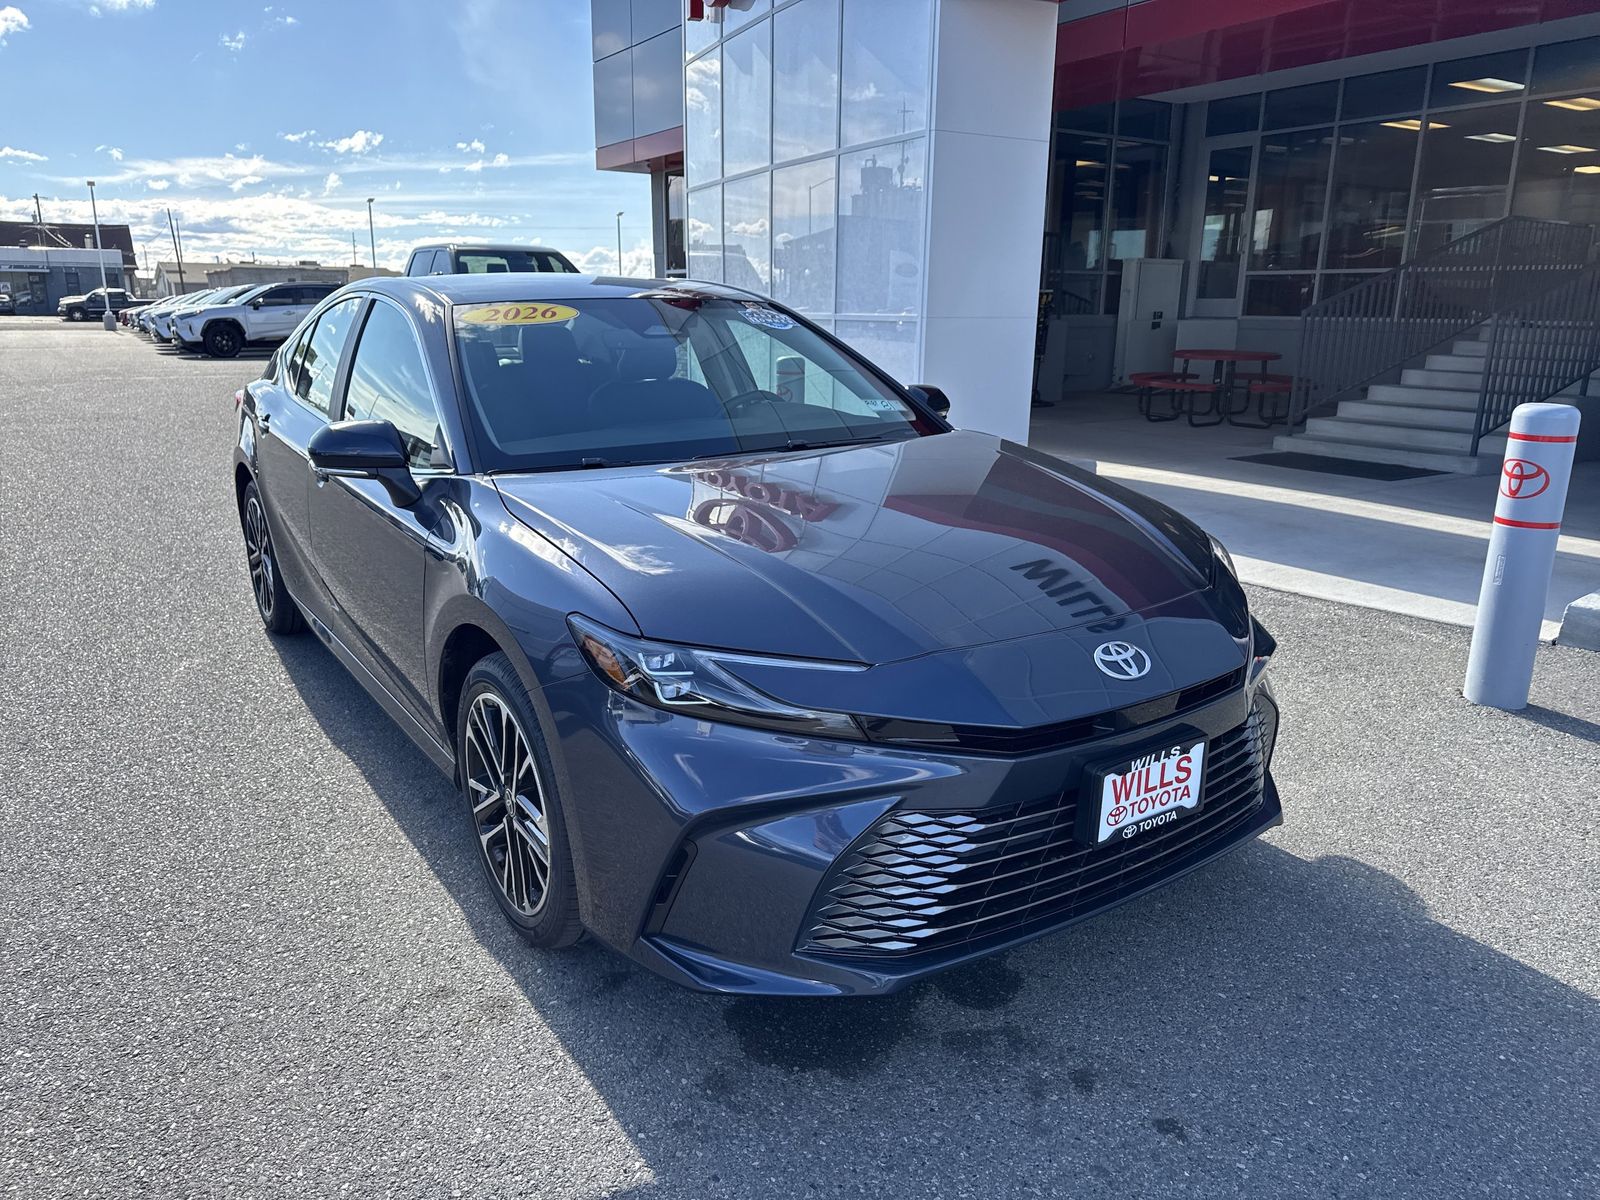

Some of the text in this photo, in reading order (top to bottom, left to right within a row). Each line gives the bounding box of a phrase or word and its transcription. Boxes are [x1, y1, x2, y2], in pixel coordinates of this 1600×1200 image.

[482, 306, 558, 322] 2026
[1131, 746, 1181, 773] WILLS
[1111, 755, 1192, 806] WILLS
[1129, 785, 1191, 818] TOYOTA
[1138, 810, 1177, 832] TOYOTA
